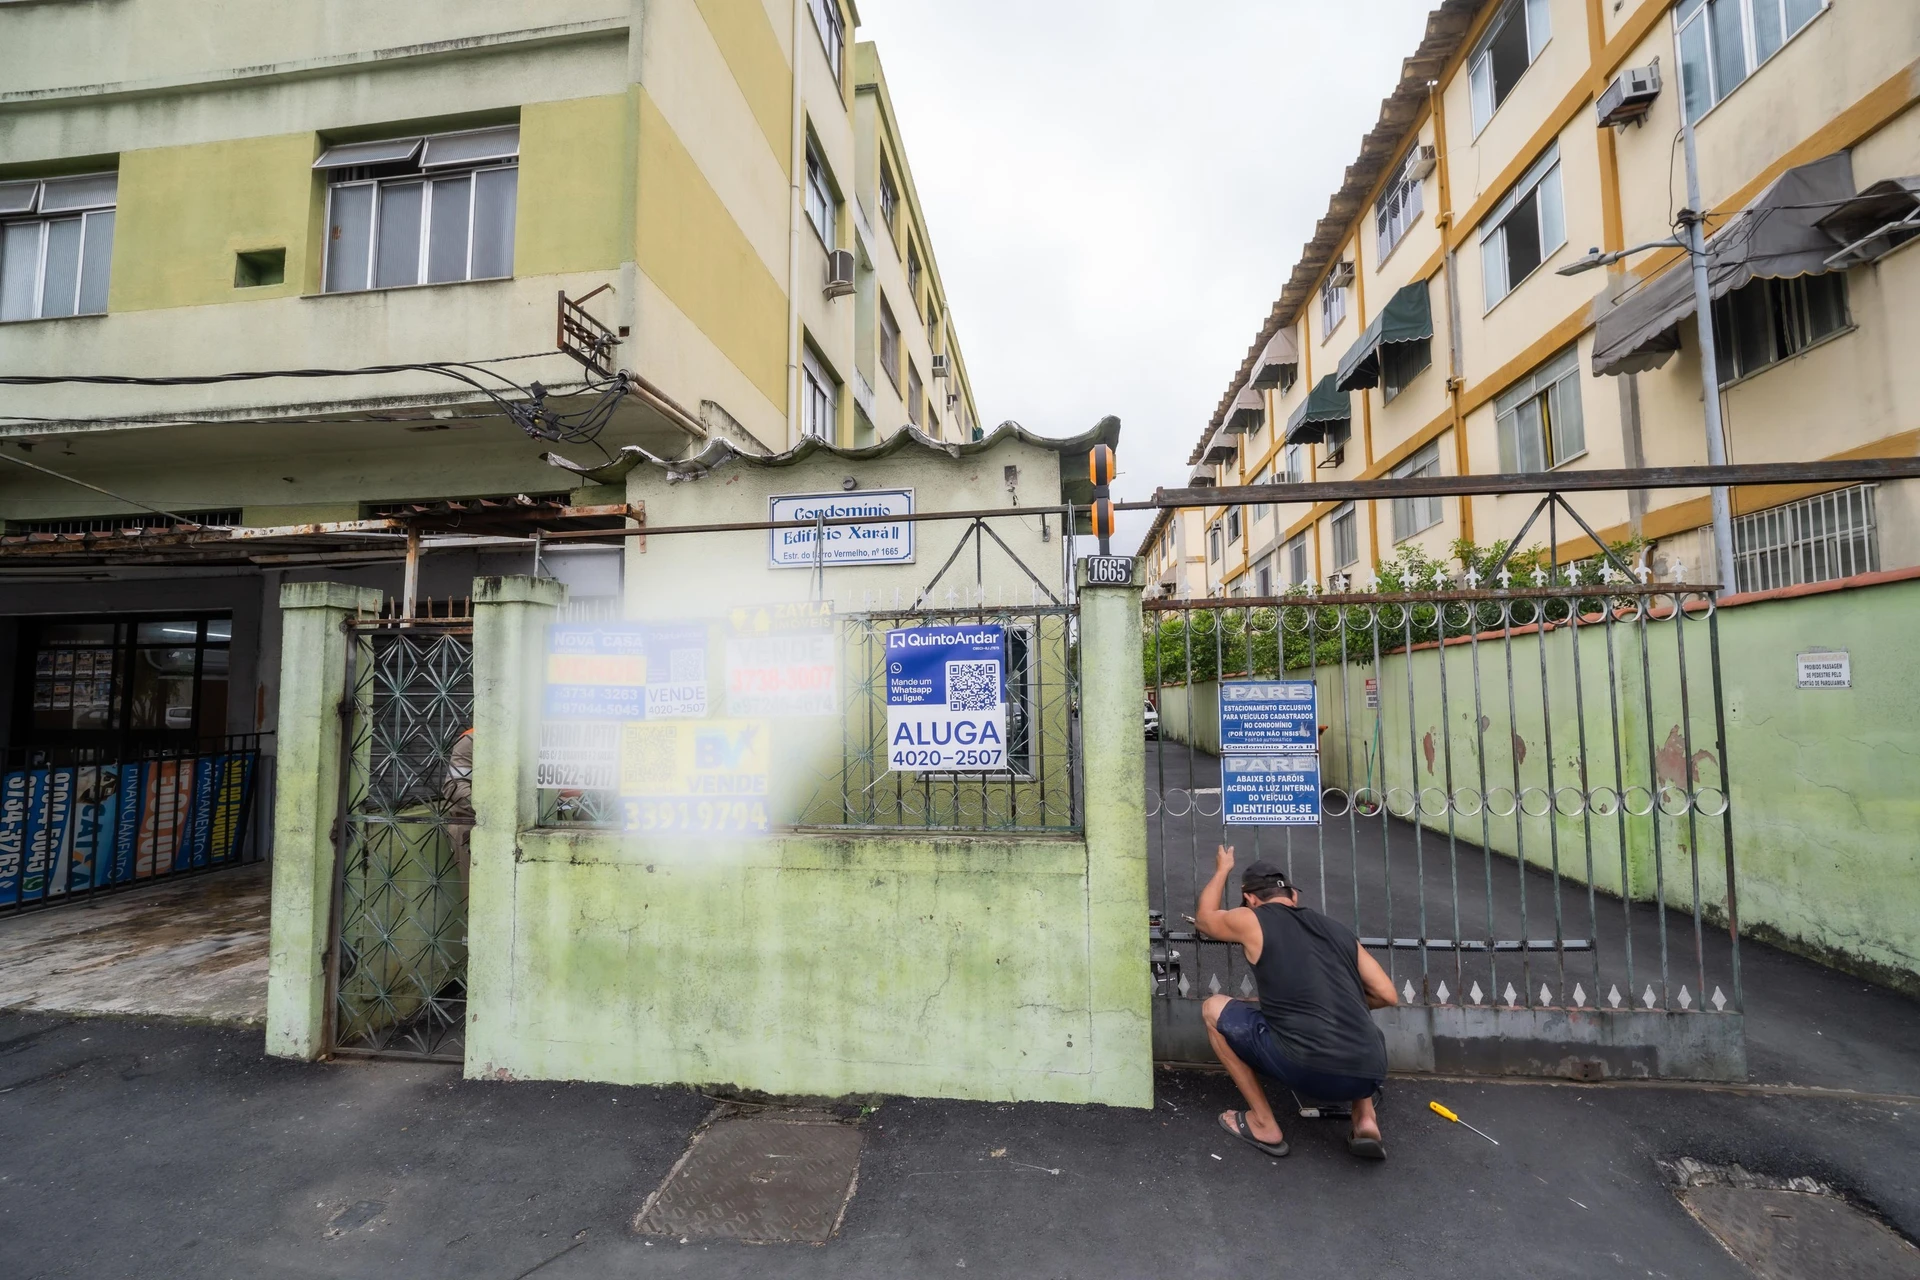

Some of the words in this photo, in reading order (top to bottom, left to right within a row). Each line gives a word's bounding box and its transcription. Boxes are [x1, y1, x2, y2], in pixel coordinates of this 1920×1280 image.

[794, 503, 890, 521] Condomínio
[849, 526, 889, 540] Xará
[784, 551, 800, 560] Estr.
[801, 550, 811, 559] do
[833, 549, 870, 559] Vermelho,
[881, 547, 899, 556] 1665
[1092, 558, 1127, 582] 1665
[774, 603, 831, 617] ZAYLA
[775, 616, 831, 631] IMÓVEIS
[554, 632, 595, 647] NOVA
[602, 635, 643, 647] CASA
[908, 631, 1000, 647] QuintoAndar
[735, 637, 826, 666] VENDE
[555, 657, 644, 682] VENDE
[731, 665, 834, 693] 3738-3007
[891, 678, 918, 686] Mande
[648, 686, 705, 703] VENDE
[891, 686, 932, 695] Whatsapp
[1229, 686, 1306, 699] PARE
[903, 694, 925, 703] ligue.
[562, 703, 639, 716] 97044-5045
[648, 703, 706, 715] 4020-2507
[1224, 704, 1277, 712] ESTACIONAMENTO
[1239, 712, 1269, 720] VEÍCULOS
[1254, 721, 1292, 729] CONDOMÍNIO
[541, 724, 581, 748] VENDO
[583, 724, 616, 749] APTO
[893, 720, 1001, 746] ALUGA
[1266, 729, 1280, 737] NÃO
[893, 750, 1002, 766] 4020-2507
[1229, 759, 1311, 771] PARE
[537, 763, 613, 787] 99622-8717
[1236, 775, 1264, 783] ABAIXE
[1265, 775, 1276, 783] OS
[1278, 774, 1305, 783] FARÓIS
[687, 773, 768, 793] VENDE
[1227, 784, 1257, 792] ACENDA
[1266, 784, 1280, 792] LUZ
[1282, 784, 1315, 792] INTERNA
[1261, 793, 1294, 801] VEÍCULO
[1233, 804, 1312, 814] IDENTIFIQUE-SE
[107, 768, 138, 880] FINANCIAMENTO
[64, 804, 107, 891] CAIXA
